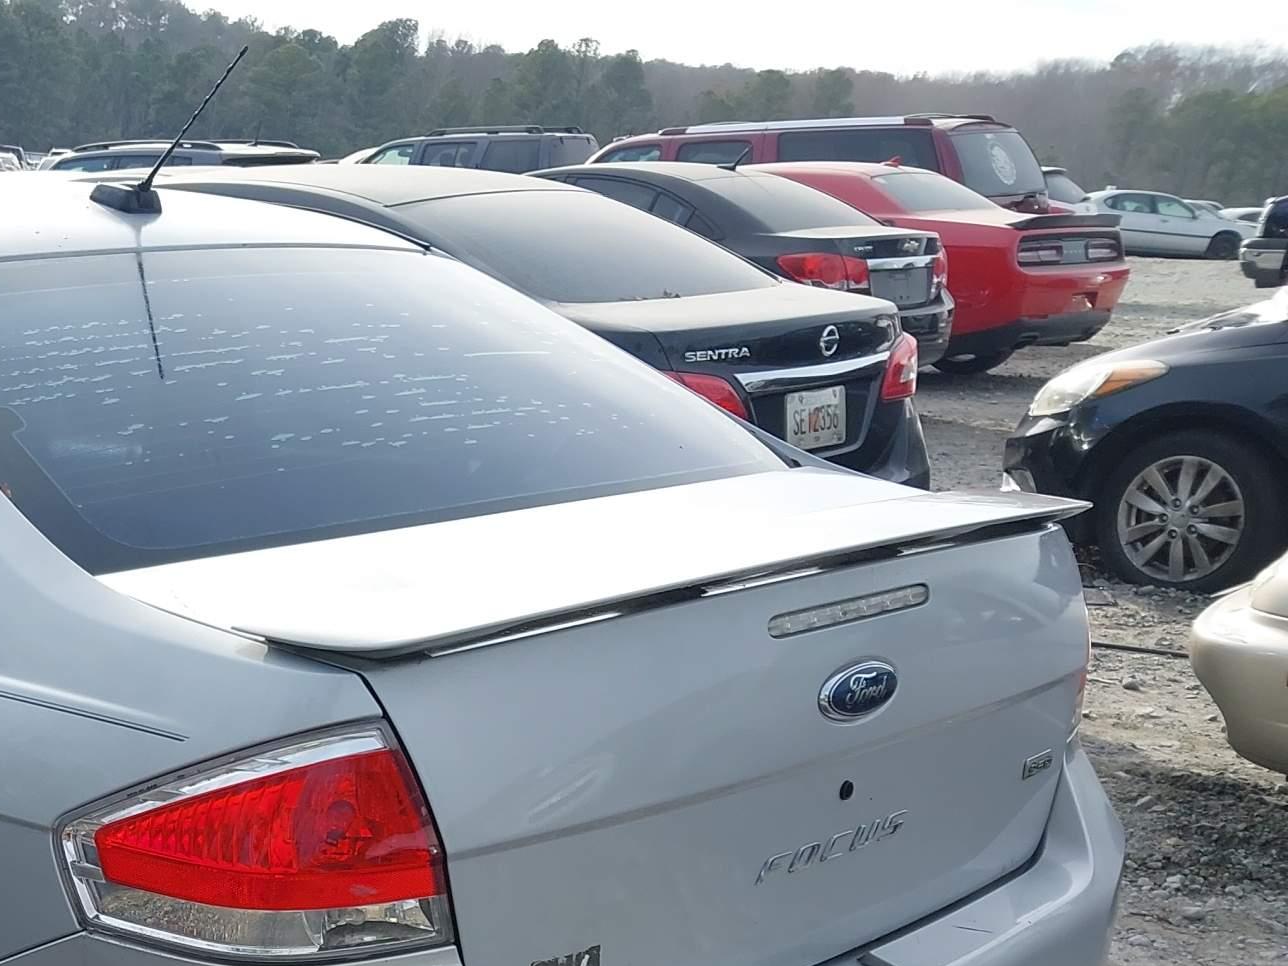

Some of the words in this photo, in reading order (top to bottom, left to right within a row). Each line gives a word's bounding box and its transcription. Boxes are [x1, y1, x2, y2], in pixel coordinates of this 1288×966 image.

[684, 347, 752, 363] SENTRA
[844, 671, 889, 709] Ford
[754, 809, 909, 887] FOCUS
